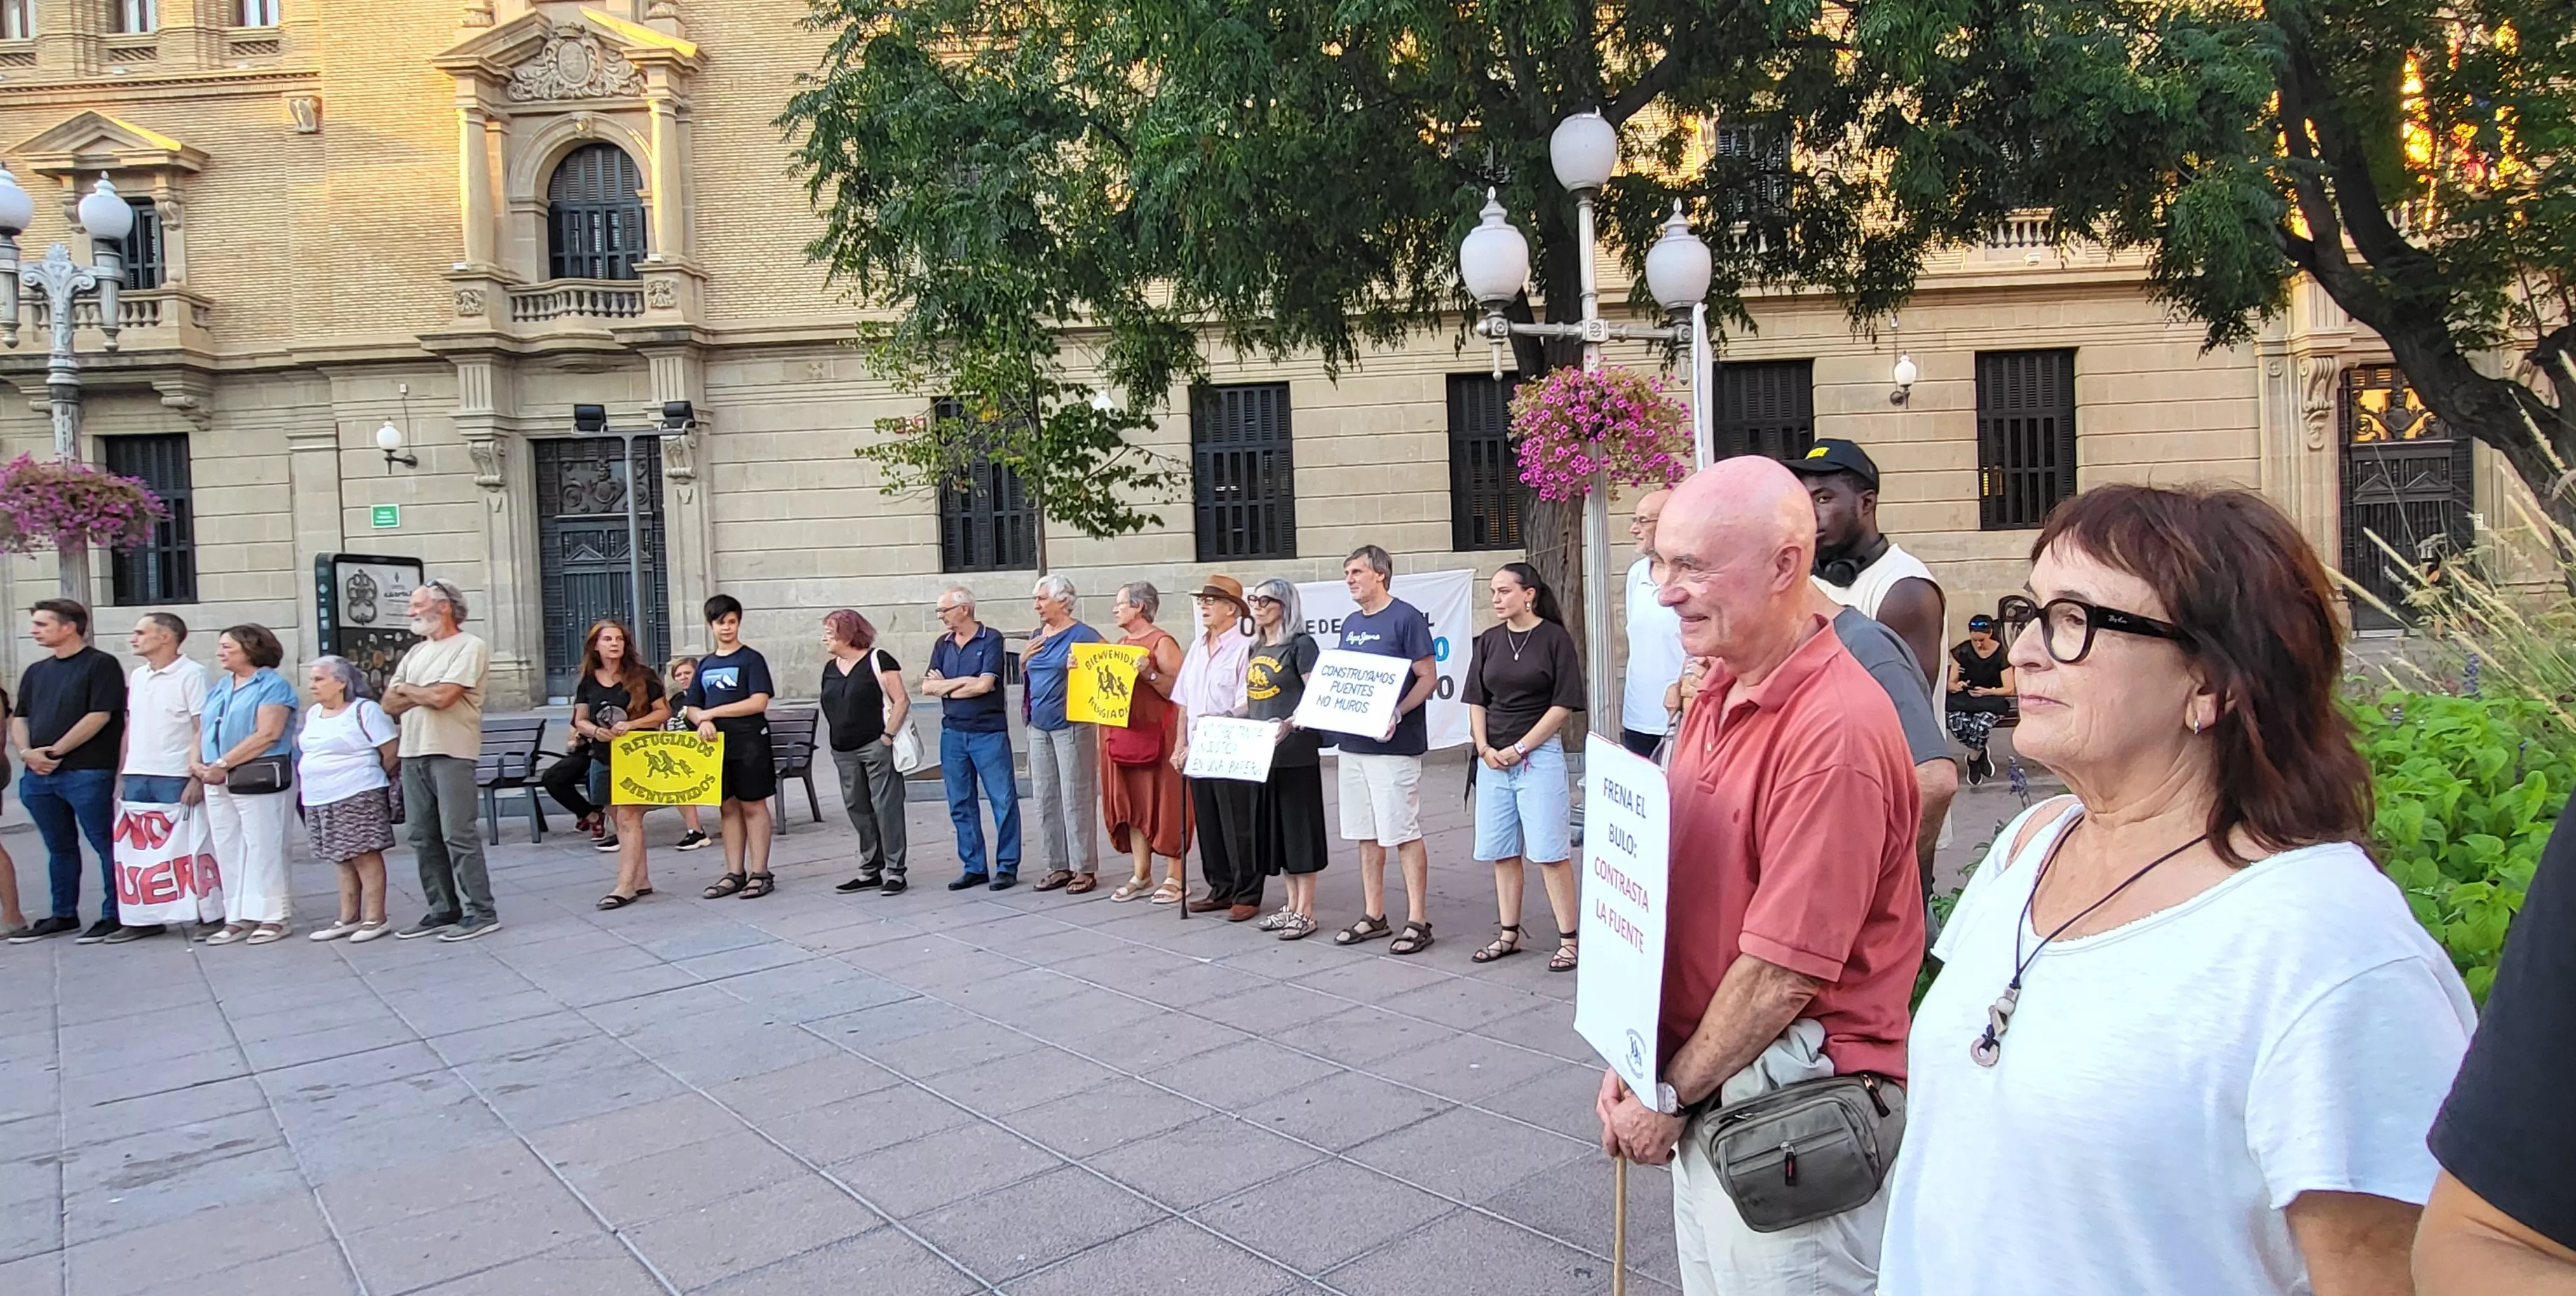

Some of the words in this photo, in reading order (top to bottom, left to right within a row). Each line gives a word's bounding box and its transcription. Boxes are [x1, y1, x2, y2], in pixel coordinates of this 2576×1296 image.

[1305, 618, 1342, 635] EDE
[1321, 665, 1397, 685] CONSTRUYAMOS
[1329, 680, 1375, 697] PUENTES
[1316, 694, 1331, 708] NO
[1334, 697, 1370, 714] MUROS
[619, 732, 716, 758] REFUGIADOS
[619, 773, 717, 804] BIENVENIDOS
[1604, 777, 1634, 812] FRENA
[1635, 793, 1647, 819] EL
[114, 809, 175, 851] NO
[1608, 822, 1637, 858] BULO:
[1594, 856, 1649, 913] CONTRASTA
[1596, 898, 1606, 924] LA
[1608, 907, 1644, 954] FUENTE
